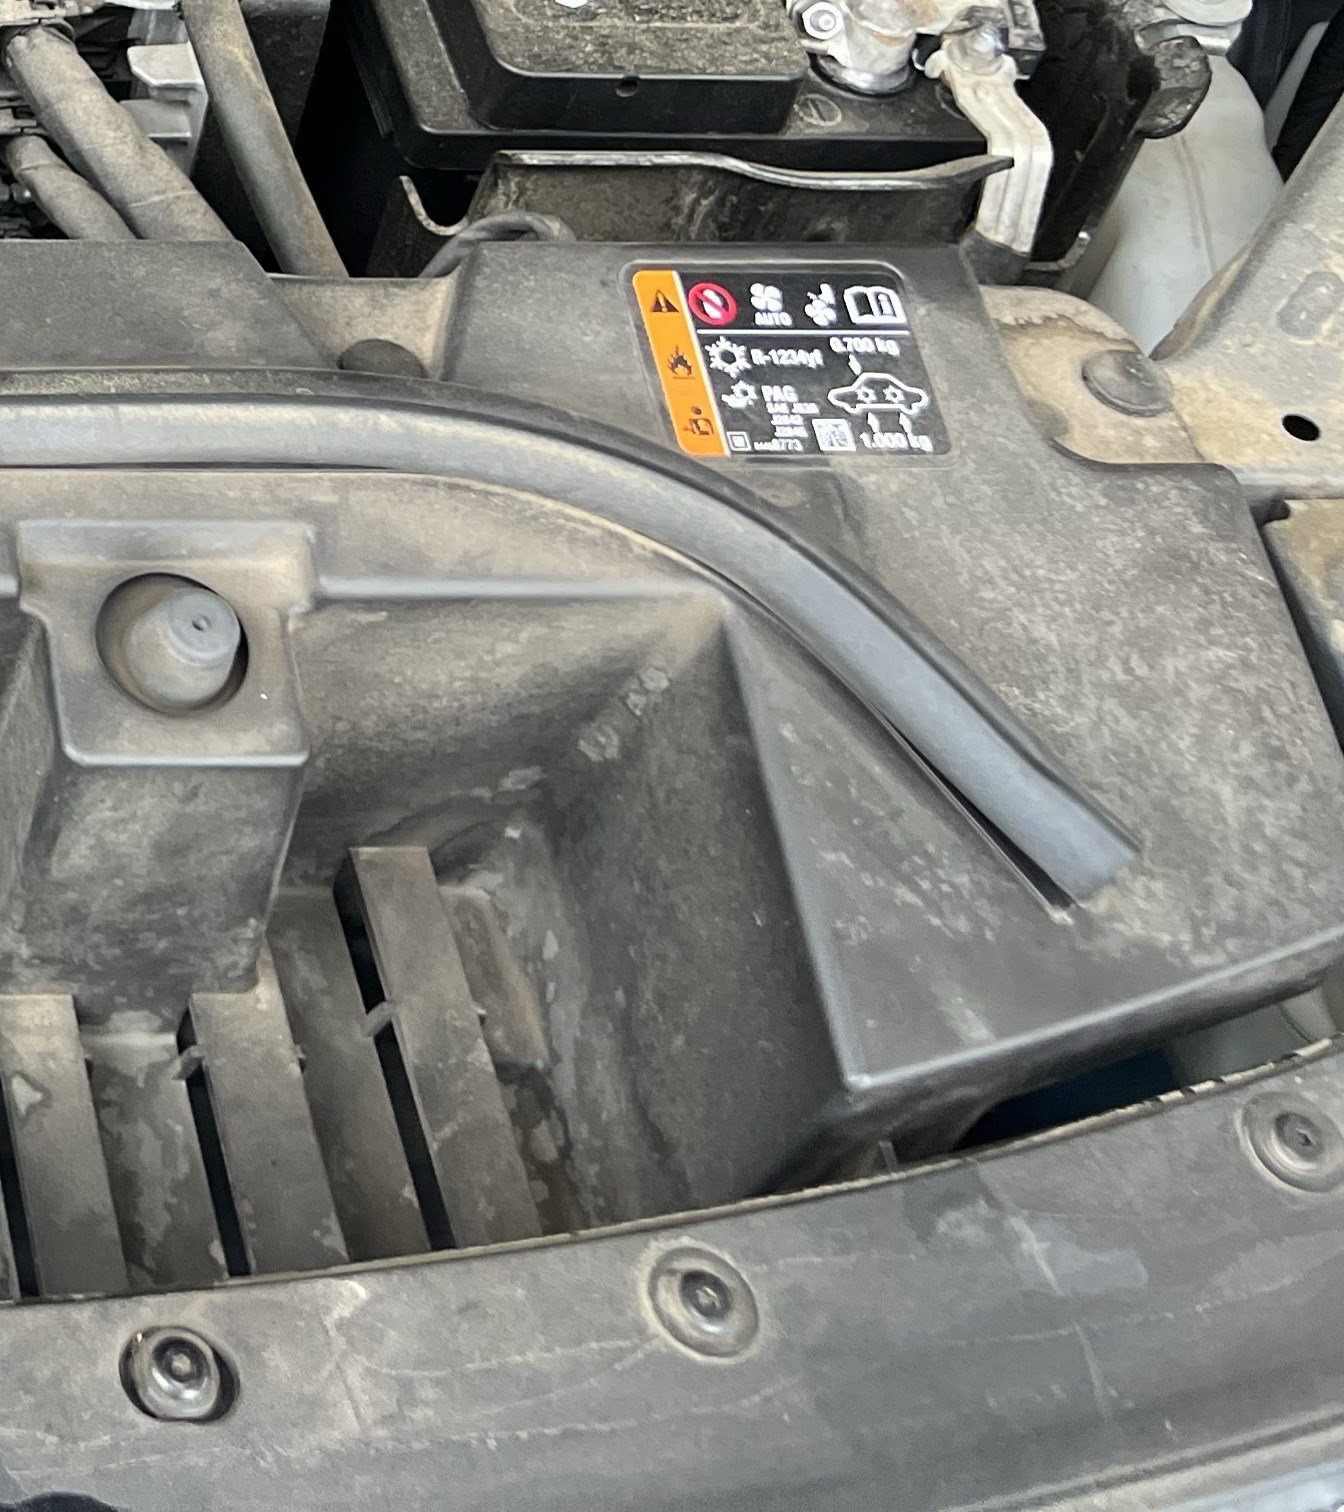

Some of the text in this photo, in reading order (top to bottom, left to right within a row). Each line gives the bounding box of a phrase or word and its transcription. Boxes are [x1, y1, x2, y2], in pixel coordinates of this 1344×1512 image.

[755, 311, 793, 326] AUTO
[874, 337, 900, 357] kg
[750, 348, 825, 369] R-1234yf
[761, 385, 799, 403] PAG
[860, 432, 933, 452] 1.000 kg
